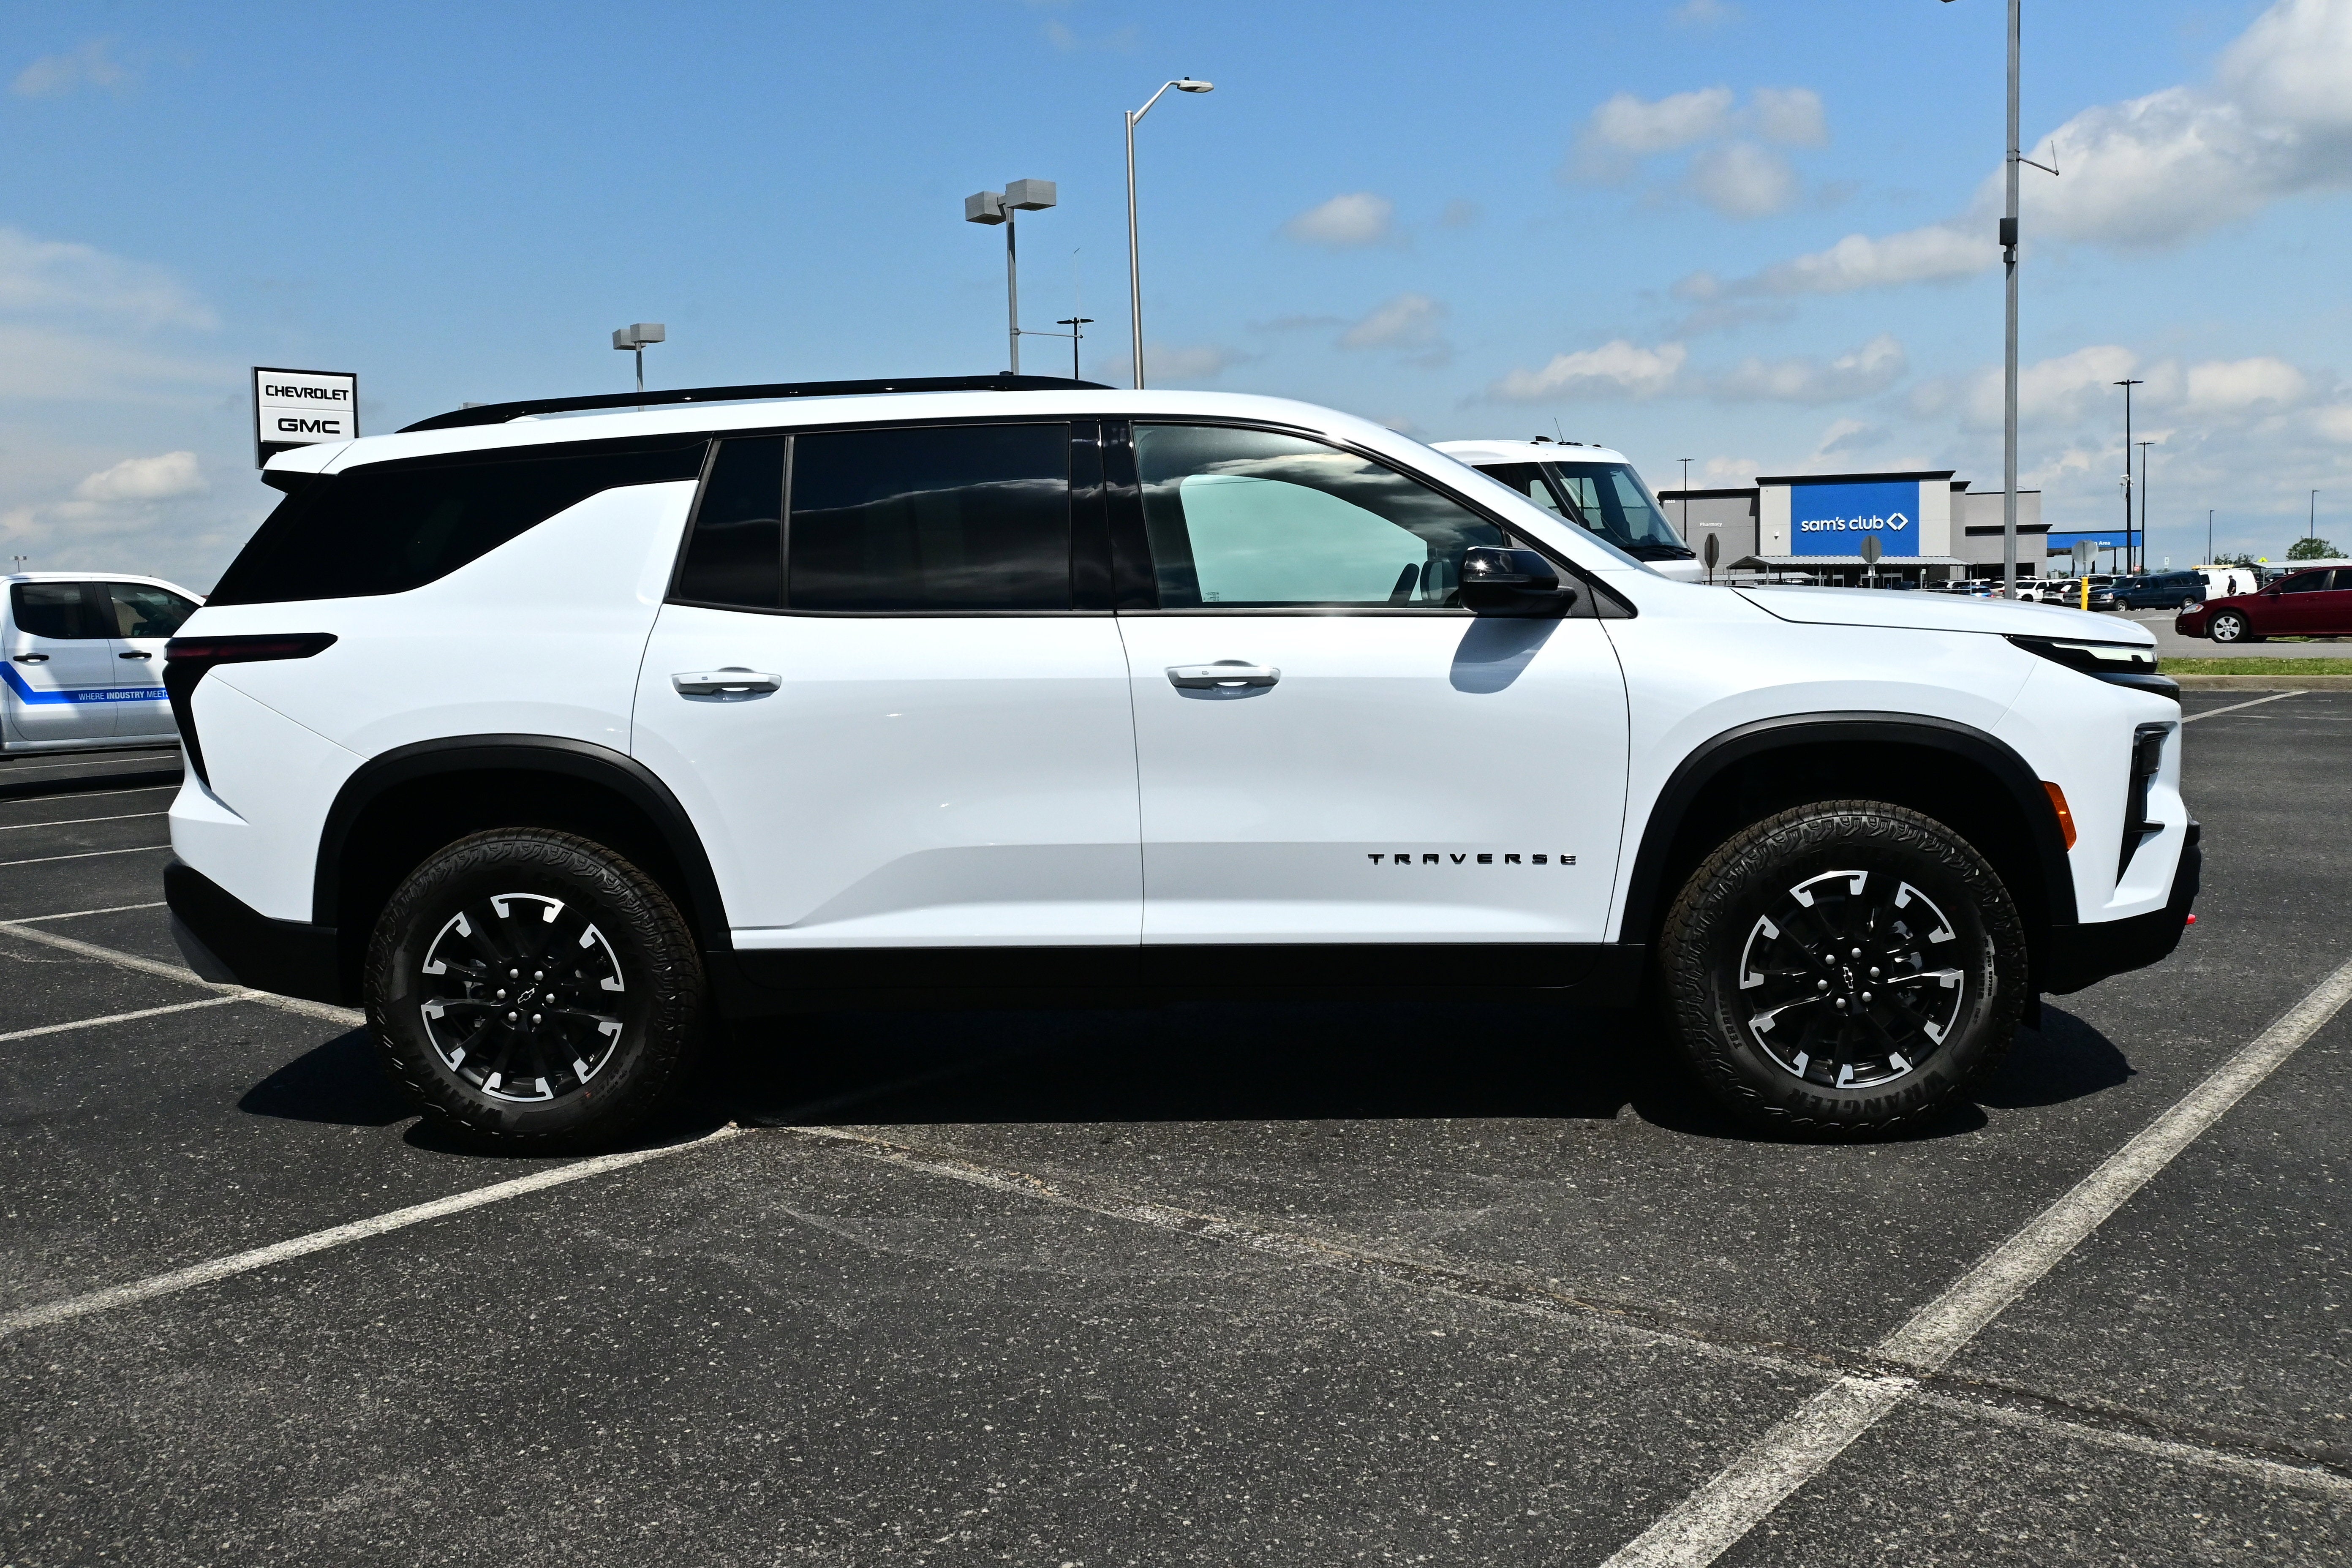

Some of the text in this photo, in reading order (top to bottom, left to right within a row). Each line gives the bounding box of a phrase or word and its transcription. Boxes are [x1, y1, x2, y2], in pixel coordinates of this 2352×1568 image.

[265, 385, 349, 401] CHEVROLET
[278, 418, 340, 434] GMC
[1801, 515, 1884, 531] sam's club
[106, 691, 144, 699] INDUSTRY
[1367, 853, 1576, 866] TRAVERSE
[1786, 1070, 1948, 1115] WRANGLER
